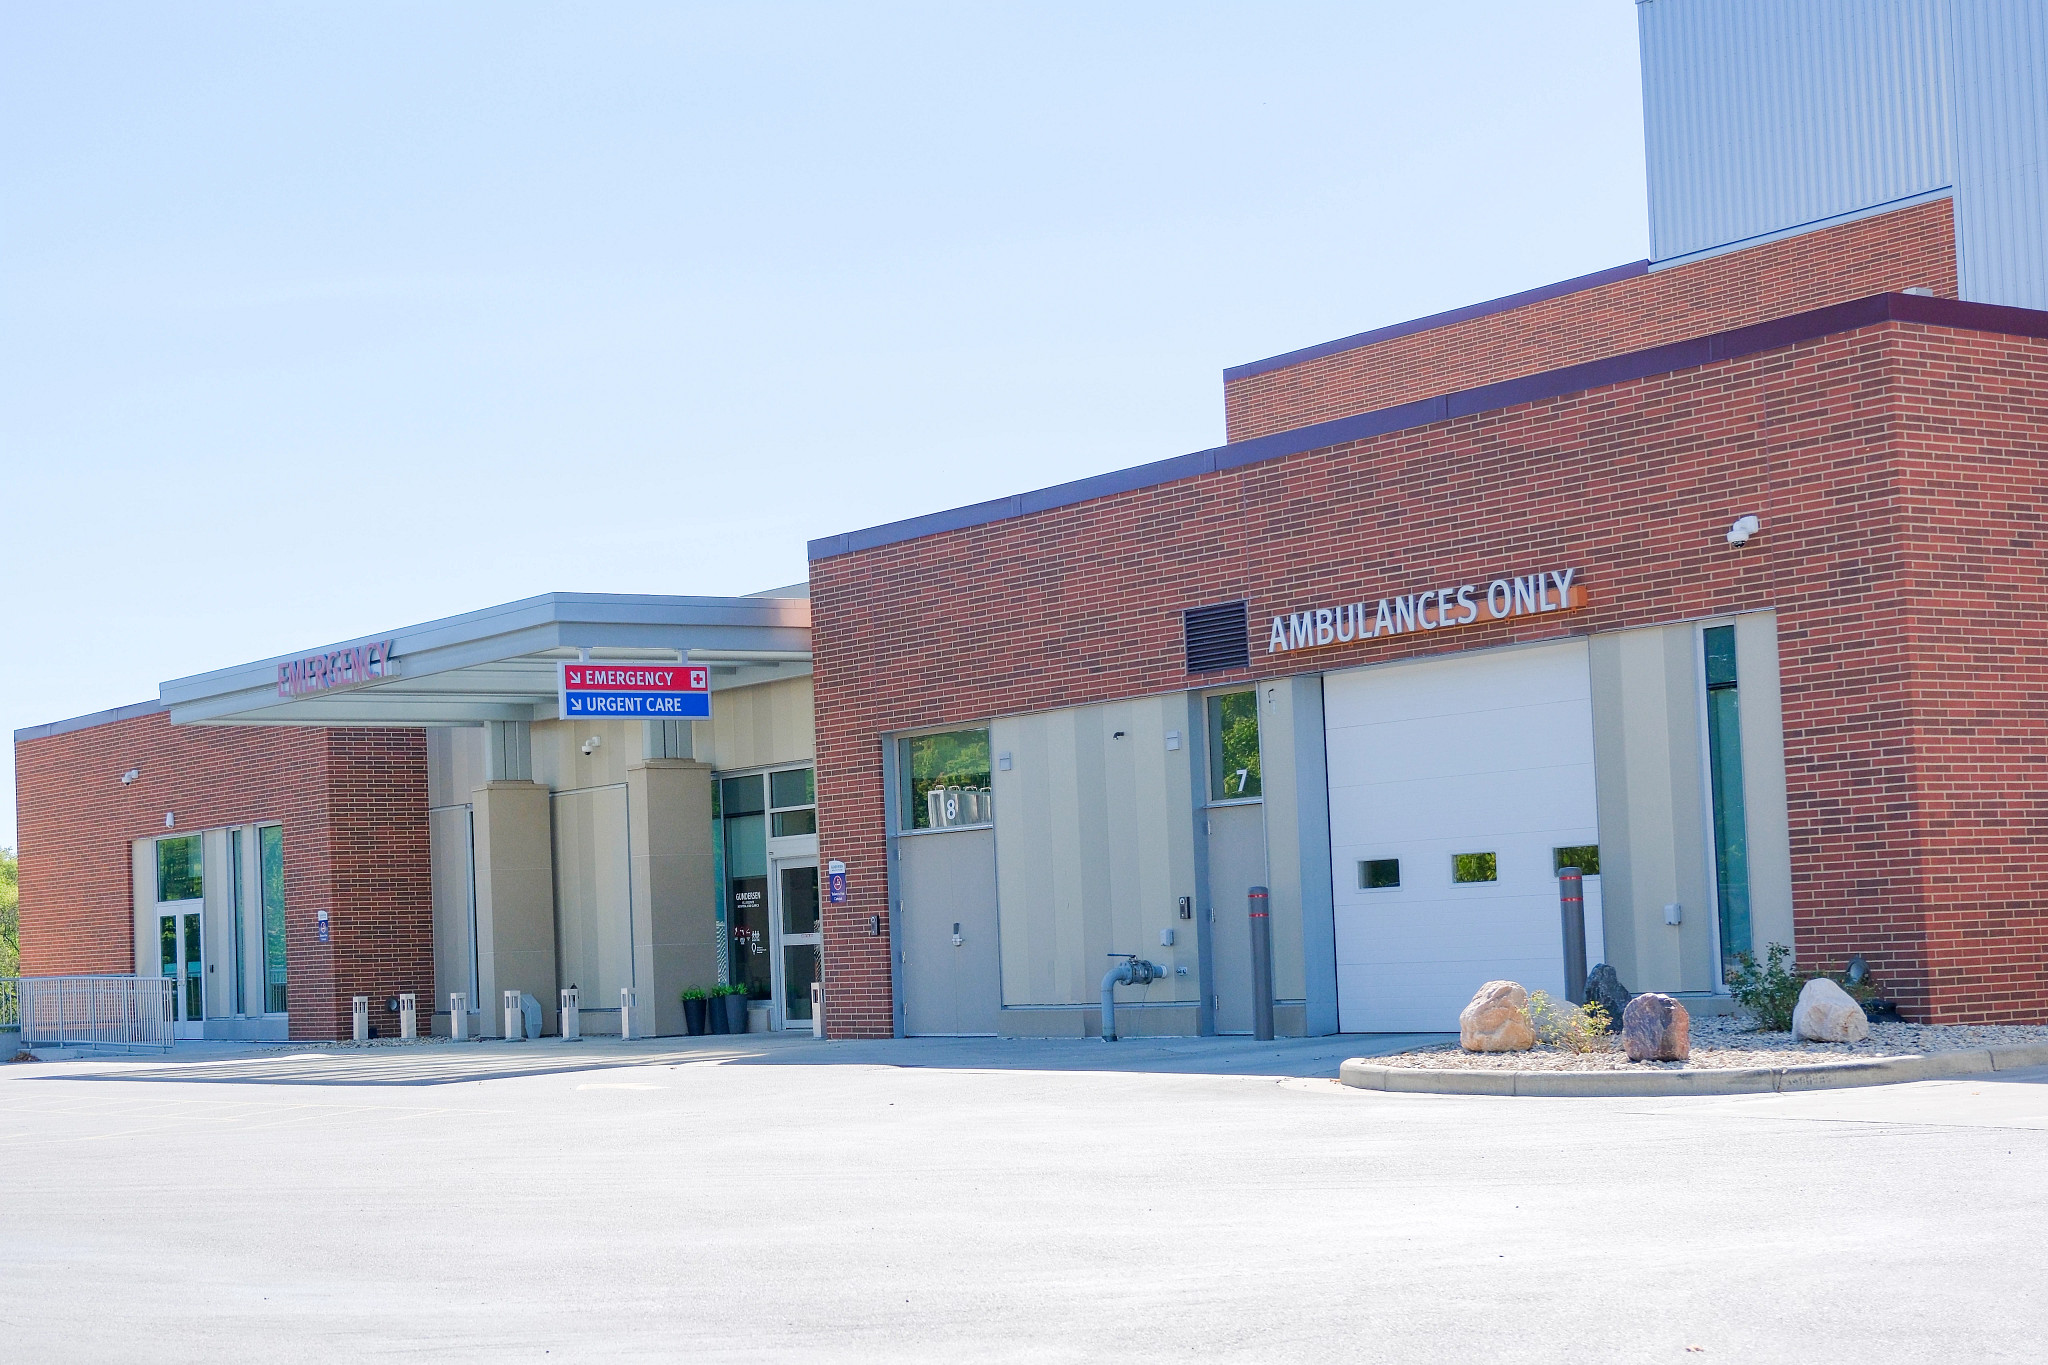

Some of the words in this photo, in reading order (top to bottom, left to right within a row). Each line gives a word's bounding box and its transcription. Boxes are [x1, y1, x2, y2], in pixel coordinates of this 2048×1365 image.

[1268, 584, 1478, 653] AMBULANCES
[1487, 568, 1576, 619] ONLY
[278, 640, 391, 697] EMERGENCY
[585, 670, 674, 686] EMERGENCY
[586, 697, 643, 712] URGENT
[646, 697, 682, 712] CARE
[1236, 769, 1248, 792] 7
[946, 799, 956, 820] 8
